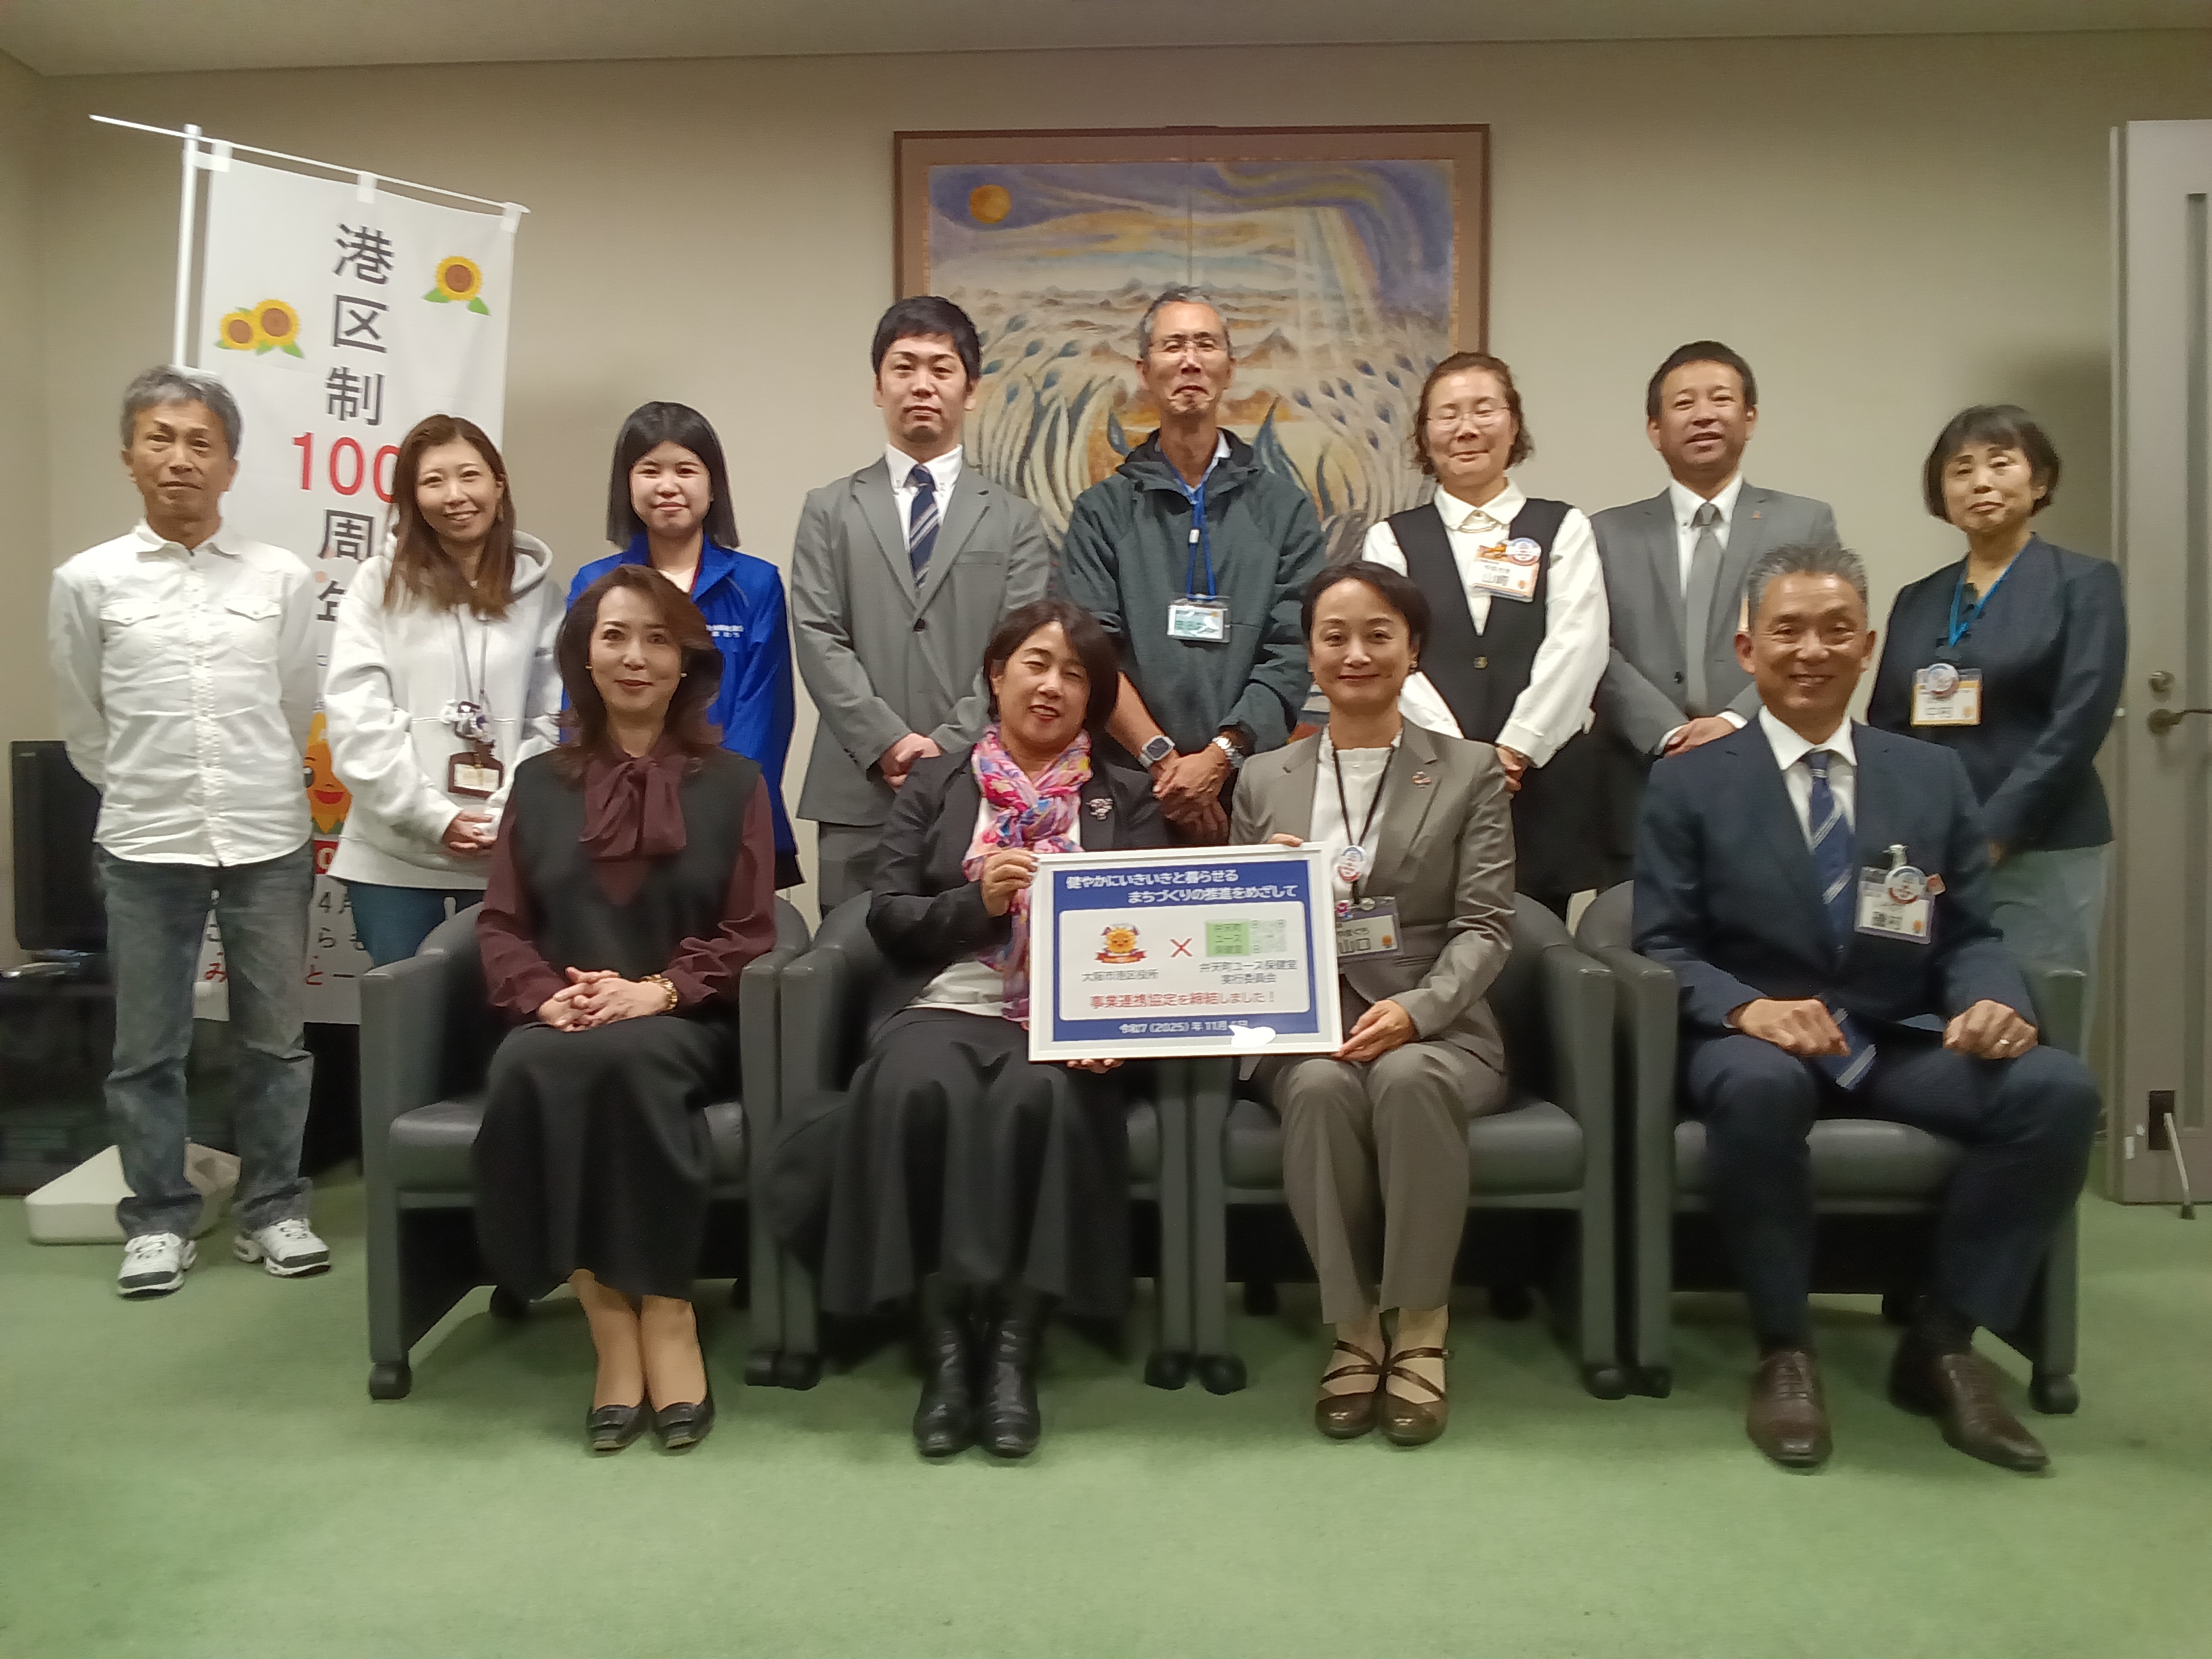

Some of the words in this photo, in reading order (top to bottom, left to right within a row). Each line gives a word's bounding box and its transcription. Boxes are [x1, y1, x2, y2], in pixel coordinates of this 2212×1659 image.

[1066, 869, 1239, 889] 健やかにいきいきと暮らせる
[1128, 884, 1298, 904] まちづくりの推進をめざして
